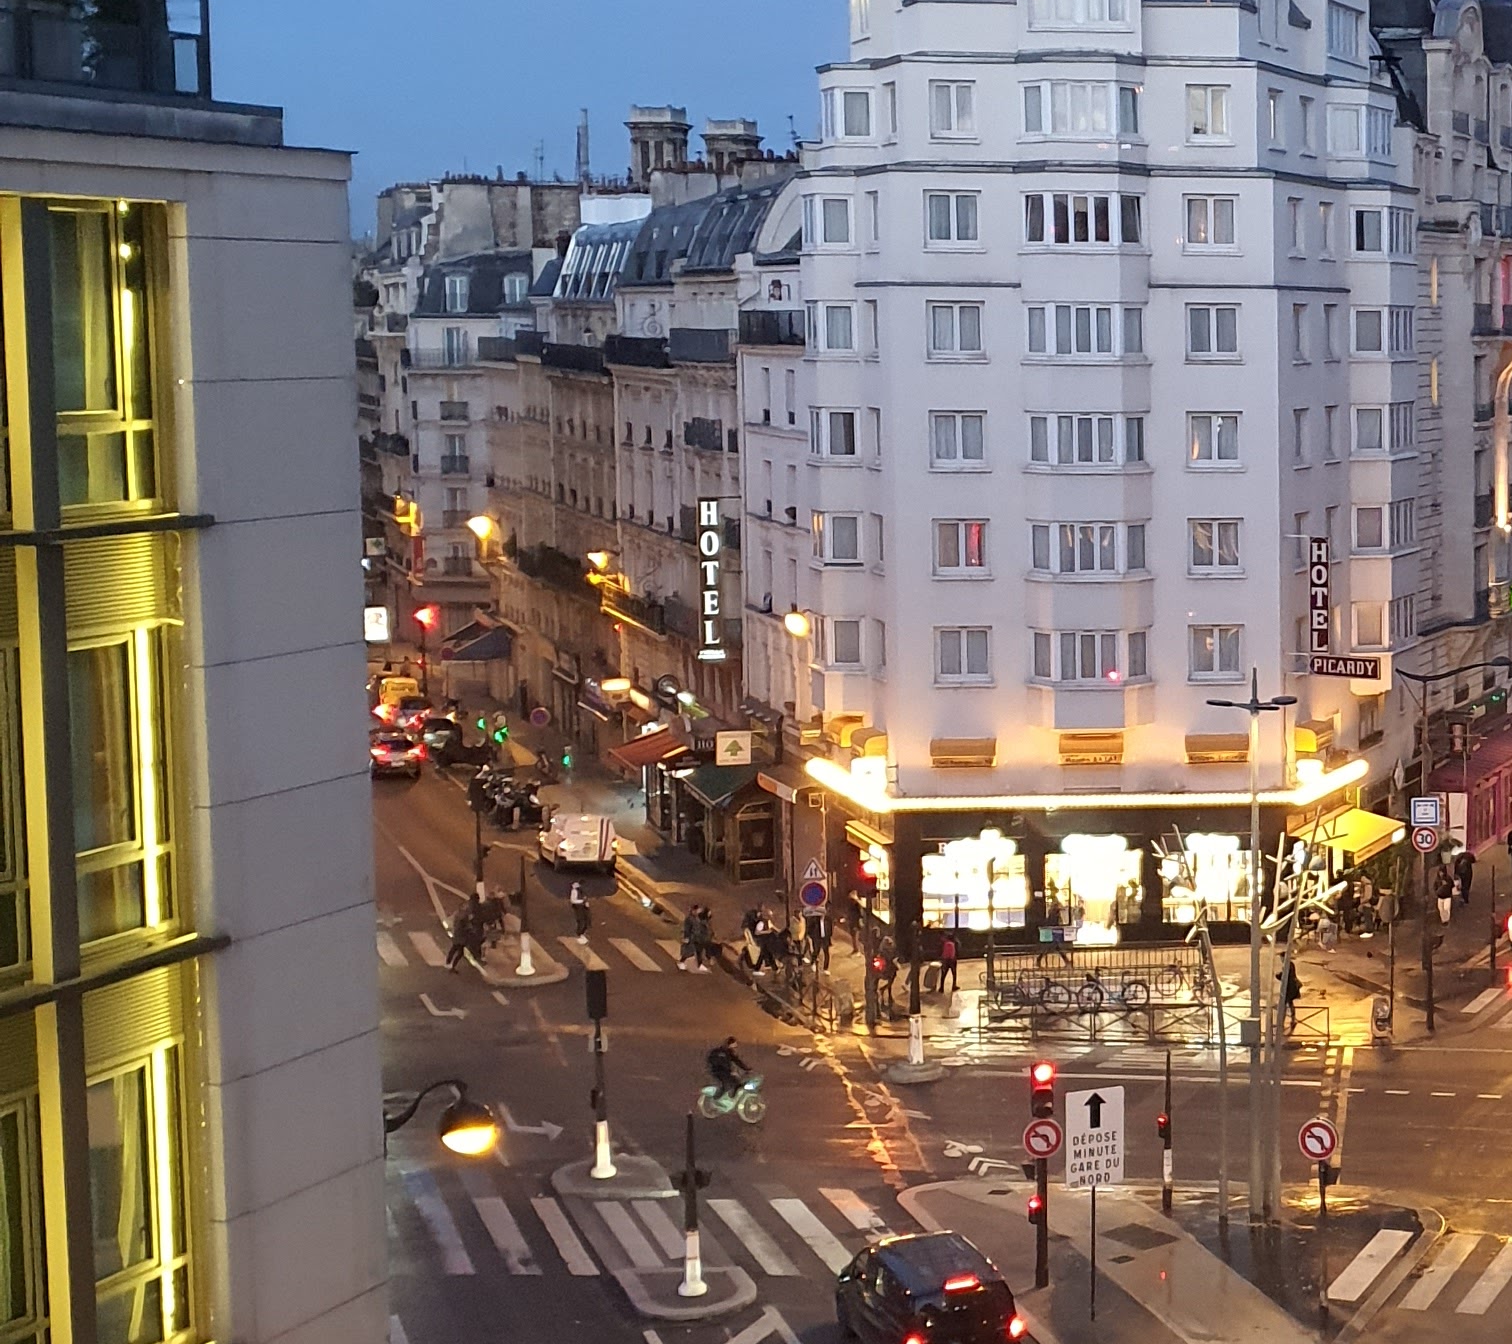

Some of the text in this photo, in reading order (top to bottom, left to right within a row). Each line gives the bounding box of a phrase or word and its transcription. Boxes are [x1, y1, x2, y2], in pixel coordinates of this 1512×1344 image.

[700, 501, 720, 644] HOTEL
[1311, 542, 1328, 651] HOTEL
[1313, 658, 1376, 676] PICARDY
[1418, 833, 1432, 844] 30
[1072, 1131, 1117, 1146] DÉPOSE
[1073, 1144, 1116, 1160] MINUTE
[1070, 1157, 1120, 1173] GARE DU
[1079, 1172, 1110, 1185] NORD
